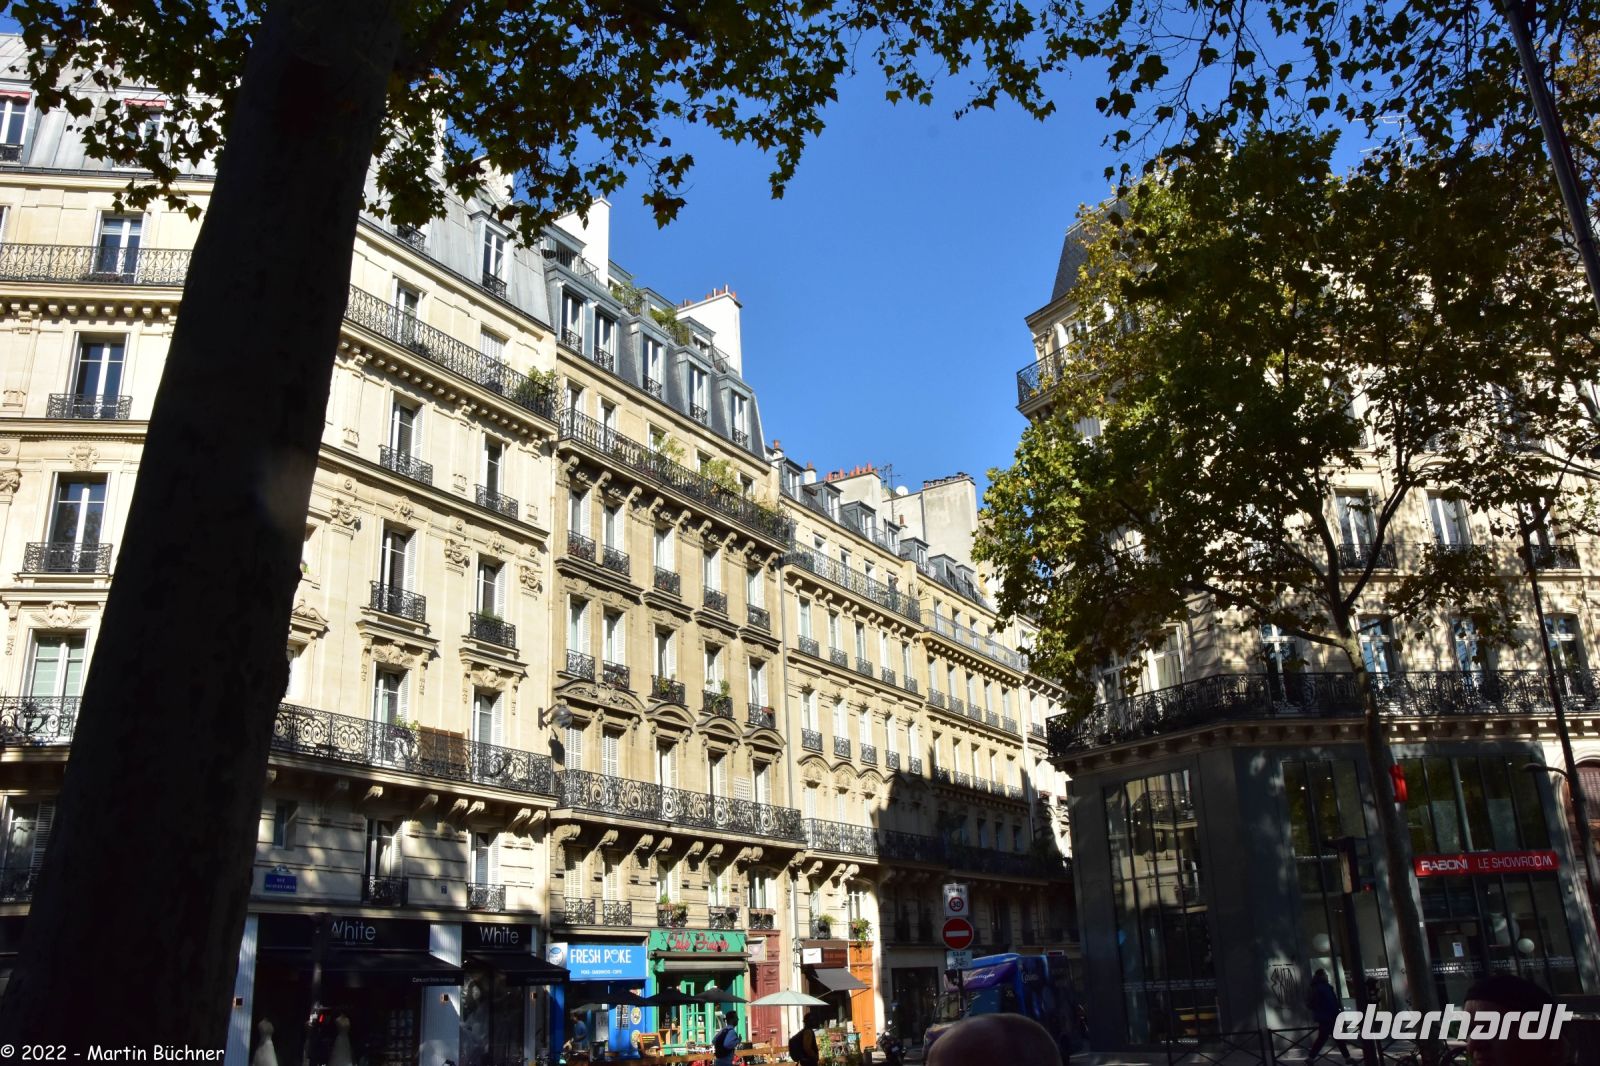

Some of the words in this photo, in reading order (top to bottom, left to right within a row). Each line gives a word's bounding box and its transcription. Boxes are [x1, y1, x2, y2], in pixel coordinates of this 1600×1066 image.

[1421, 859, 1468, 872] RABONI
[1478, 858, 1489, 869] LE
[1491, 855, 1553, 869] SHOWROOM
[331, 920, 376, 941] White
[480, 926, 519, 945] White
[570, 948, 601, 964] FRESH
[604, 948, 632, 964] POKE
